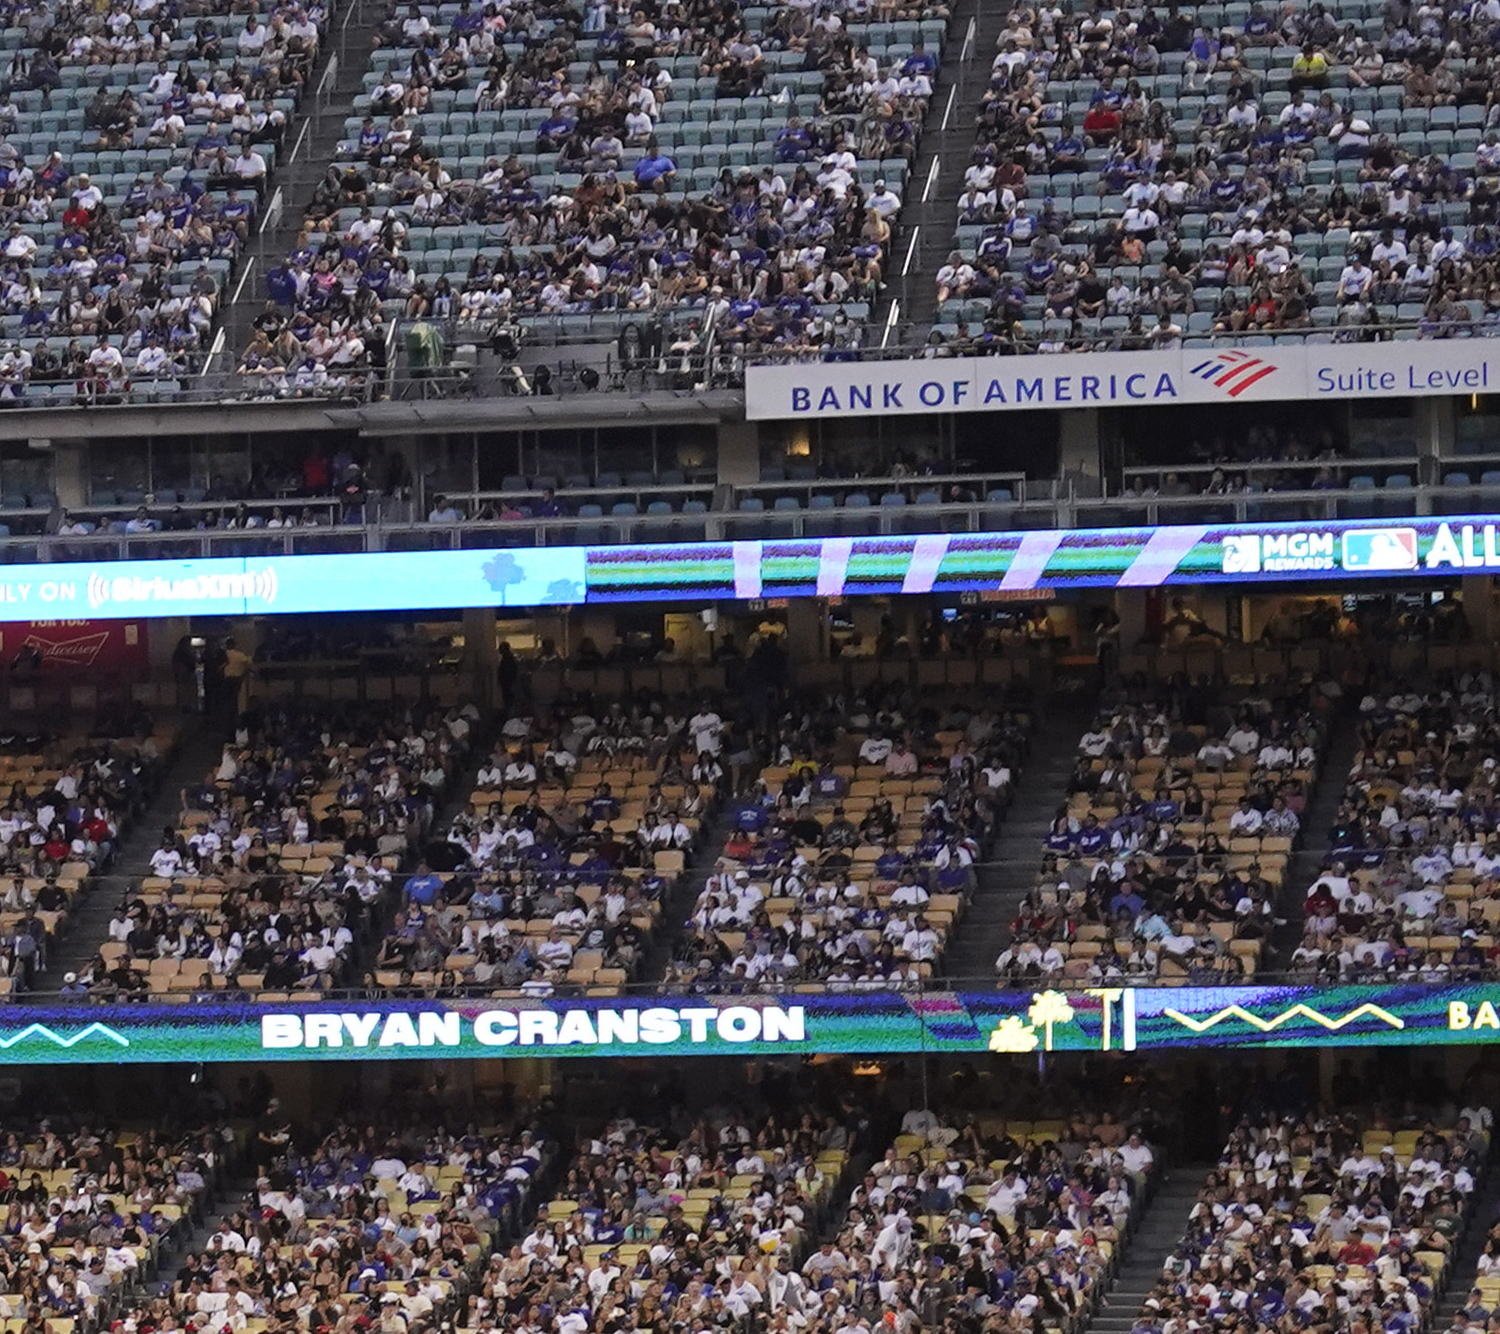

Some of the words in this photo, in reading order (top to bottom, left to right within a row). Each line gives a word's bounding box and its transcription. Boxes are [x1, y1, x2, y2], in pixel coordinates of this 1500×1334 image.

[1317, 365, 1396, 392] Suite
[1408, 362, 1487, 389] Level
[791, 381, 902, 412] BANK
[919, 380, 972, 407] OF
[982, 373, 1178, 405] AMERICA
[1264, 534, 1333, 556] MGM
[40, 581, 76, 601] ON
[262, 1012, 461, 1048] BRYAN
[474, 1006, 807, 1045] CRANSTON
